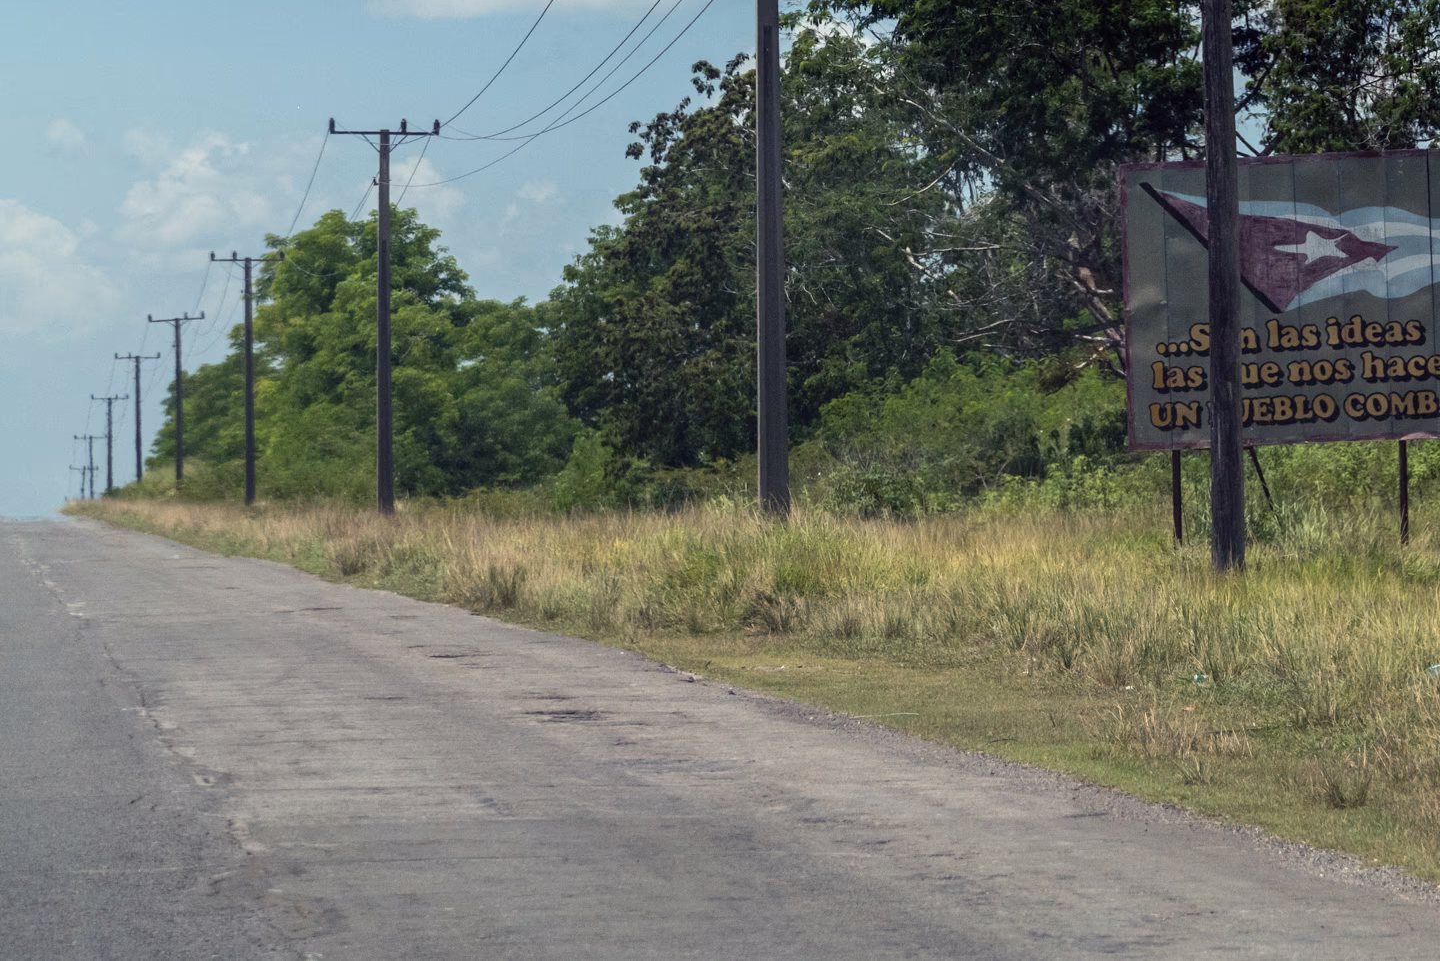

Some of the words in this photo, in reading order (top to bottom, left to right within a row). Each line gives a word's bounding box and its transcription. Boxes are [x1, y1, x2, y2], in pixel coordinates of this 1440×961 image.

[1156, 322, 1261, 356] ...Sn
[1265, 318, 1321, 352] las
[1325, 314, 1426, 351] ideas
[1151, 360, 1208, 393] las
[1241, 361, 1285, 389] ue
[1287, 358, 1356, 387] nos
[1149, 400, 1203, 431] UN
[1206, 393, 1340, 428] EBLO
